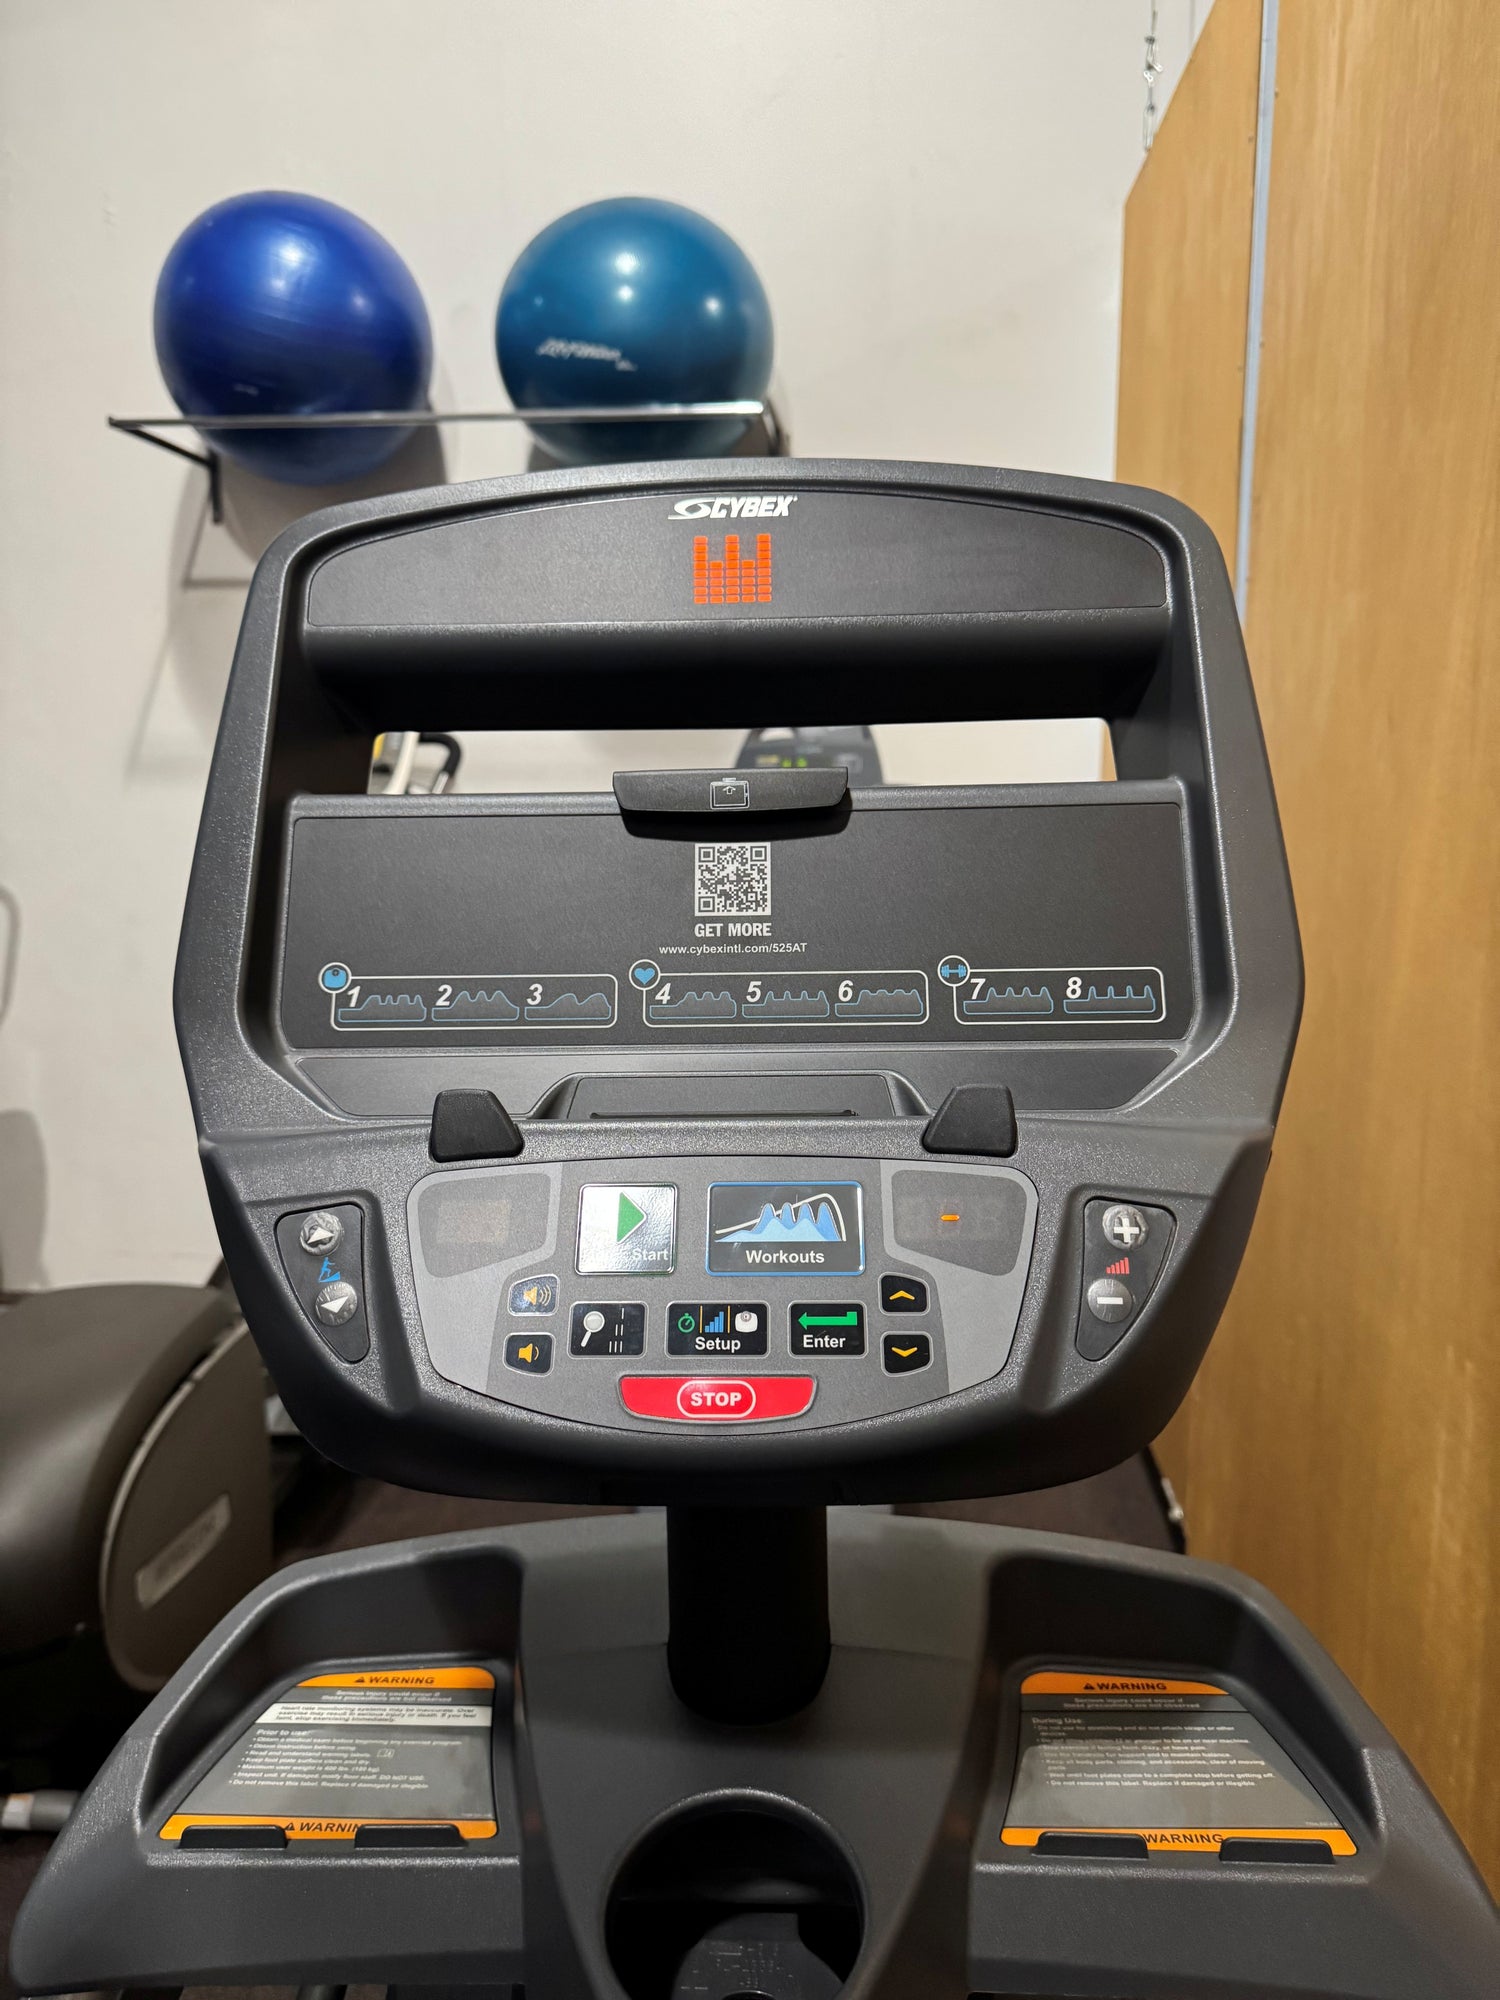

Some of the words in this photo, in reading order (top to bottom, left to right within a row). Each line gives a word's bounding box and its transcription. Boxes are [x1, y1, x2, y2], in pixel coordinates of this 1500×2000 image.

[709, 496, 797, 518] CYBEX
[694, 923, 723, 938] GET
[728, 923, 772, 937] MORE
[658, 942, 808, 956] www.cybexintl.com/525AT
[347, 985, 361, 1007] 1
[435, 984, 453, 1006] 2
[526, 983, 543, 1006] 3
[655, 982, 672, 1004] 4
[746, 980, 762, 1002] 5
[838, 980, 854, 1002] 6
[970, 978, 986, 1000] 7
[1066, 976, 1082, 999] 8
[632, 1249, 669, 1261] Start
[746, 1249, 825, 1264] Workouts
[695, 1336, 741, 1354] Setup
[803, 1334, 846, 1349] Enter
[690, 1392, 742, 1407] STOP
[369, 1676, 435, 1685] WARNING
[1097, 1682, 1167, 1690] WARNING
[299, 1822, 359, 1833] WARNI
[1143, 1833, 1224, 1844] WARNING
